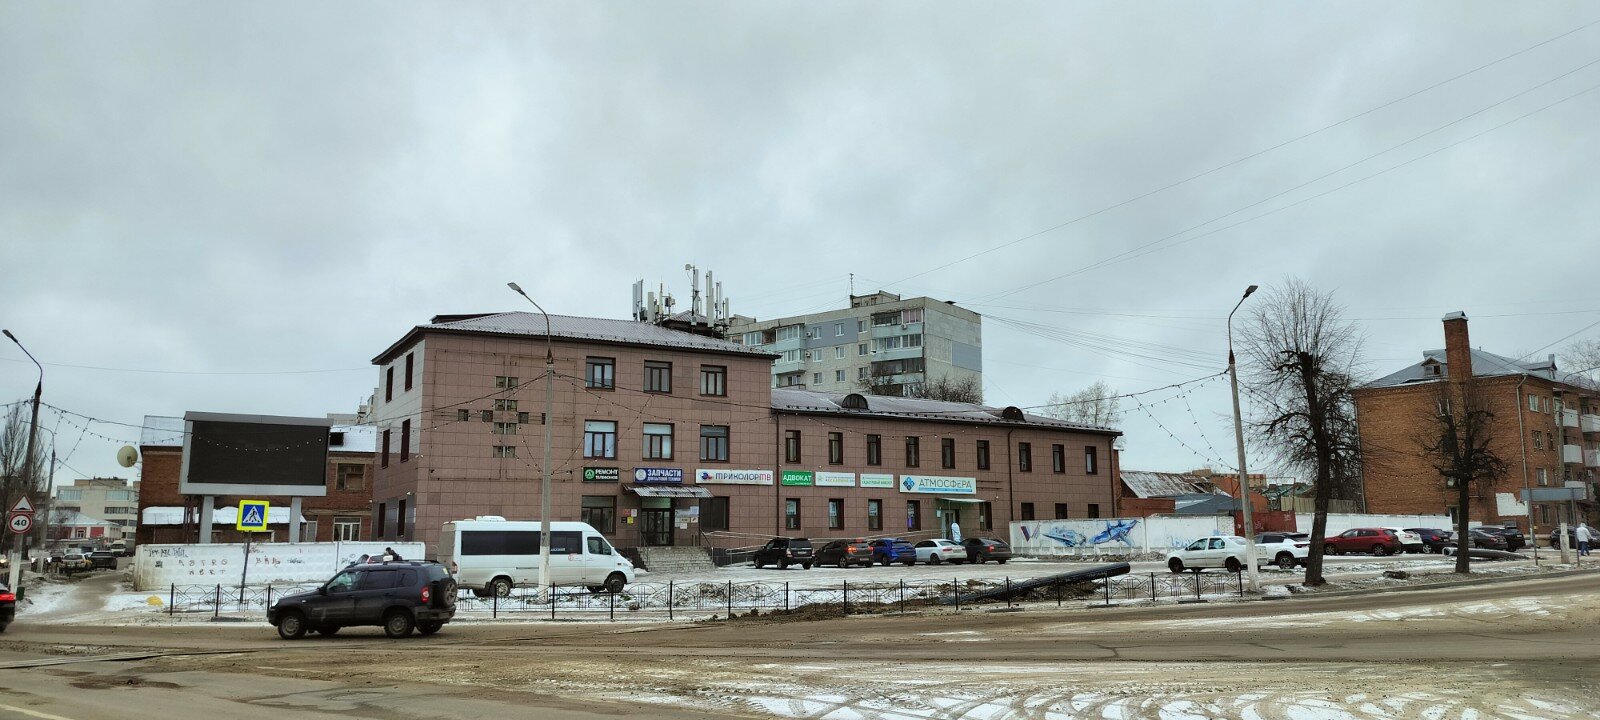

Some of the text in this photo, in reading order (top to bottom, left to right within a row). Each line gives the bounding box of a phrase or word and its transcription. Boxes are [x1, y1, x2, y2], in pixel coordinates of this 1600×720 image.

[647, 469, 681, 477] ЗАПЧАСТИ
[782, 474, 812, 482] АДВОКАТ
[918, 478, 972, 489] АТМОСФЕРА
[14, 519, 27, 527] 40
